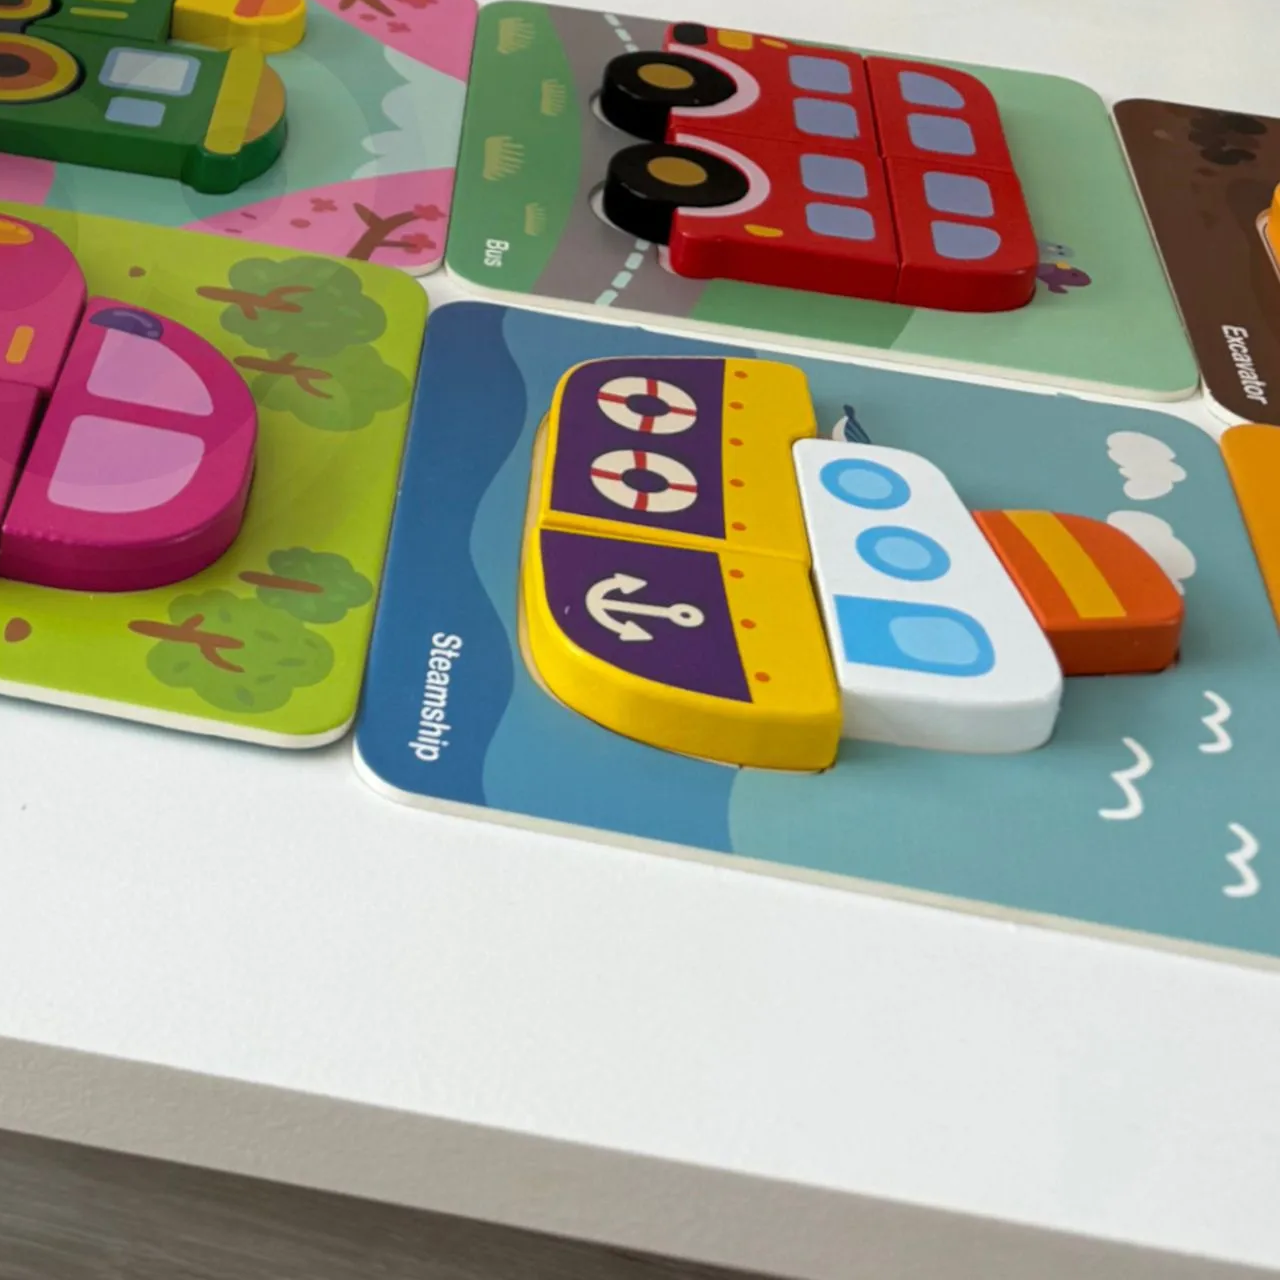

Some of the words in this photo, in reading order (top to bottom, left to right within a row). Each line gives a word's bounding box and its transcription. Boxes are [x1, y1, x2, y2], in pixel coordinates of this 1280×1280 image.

[484, 238, 509, 267] Bus
[1222, 324, 1268, 405] Excavator
[408, 632, 463, 761] Steamship
